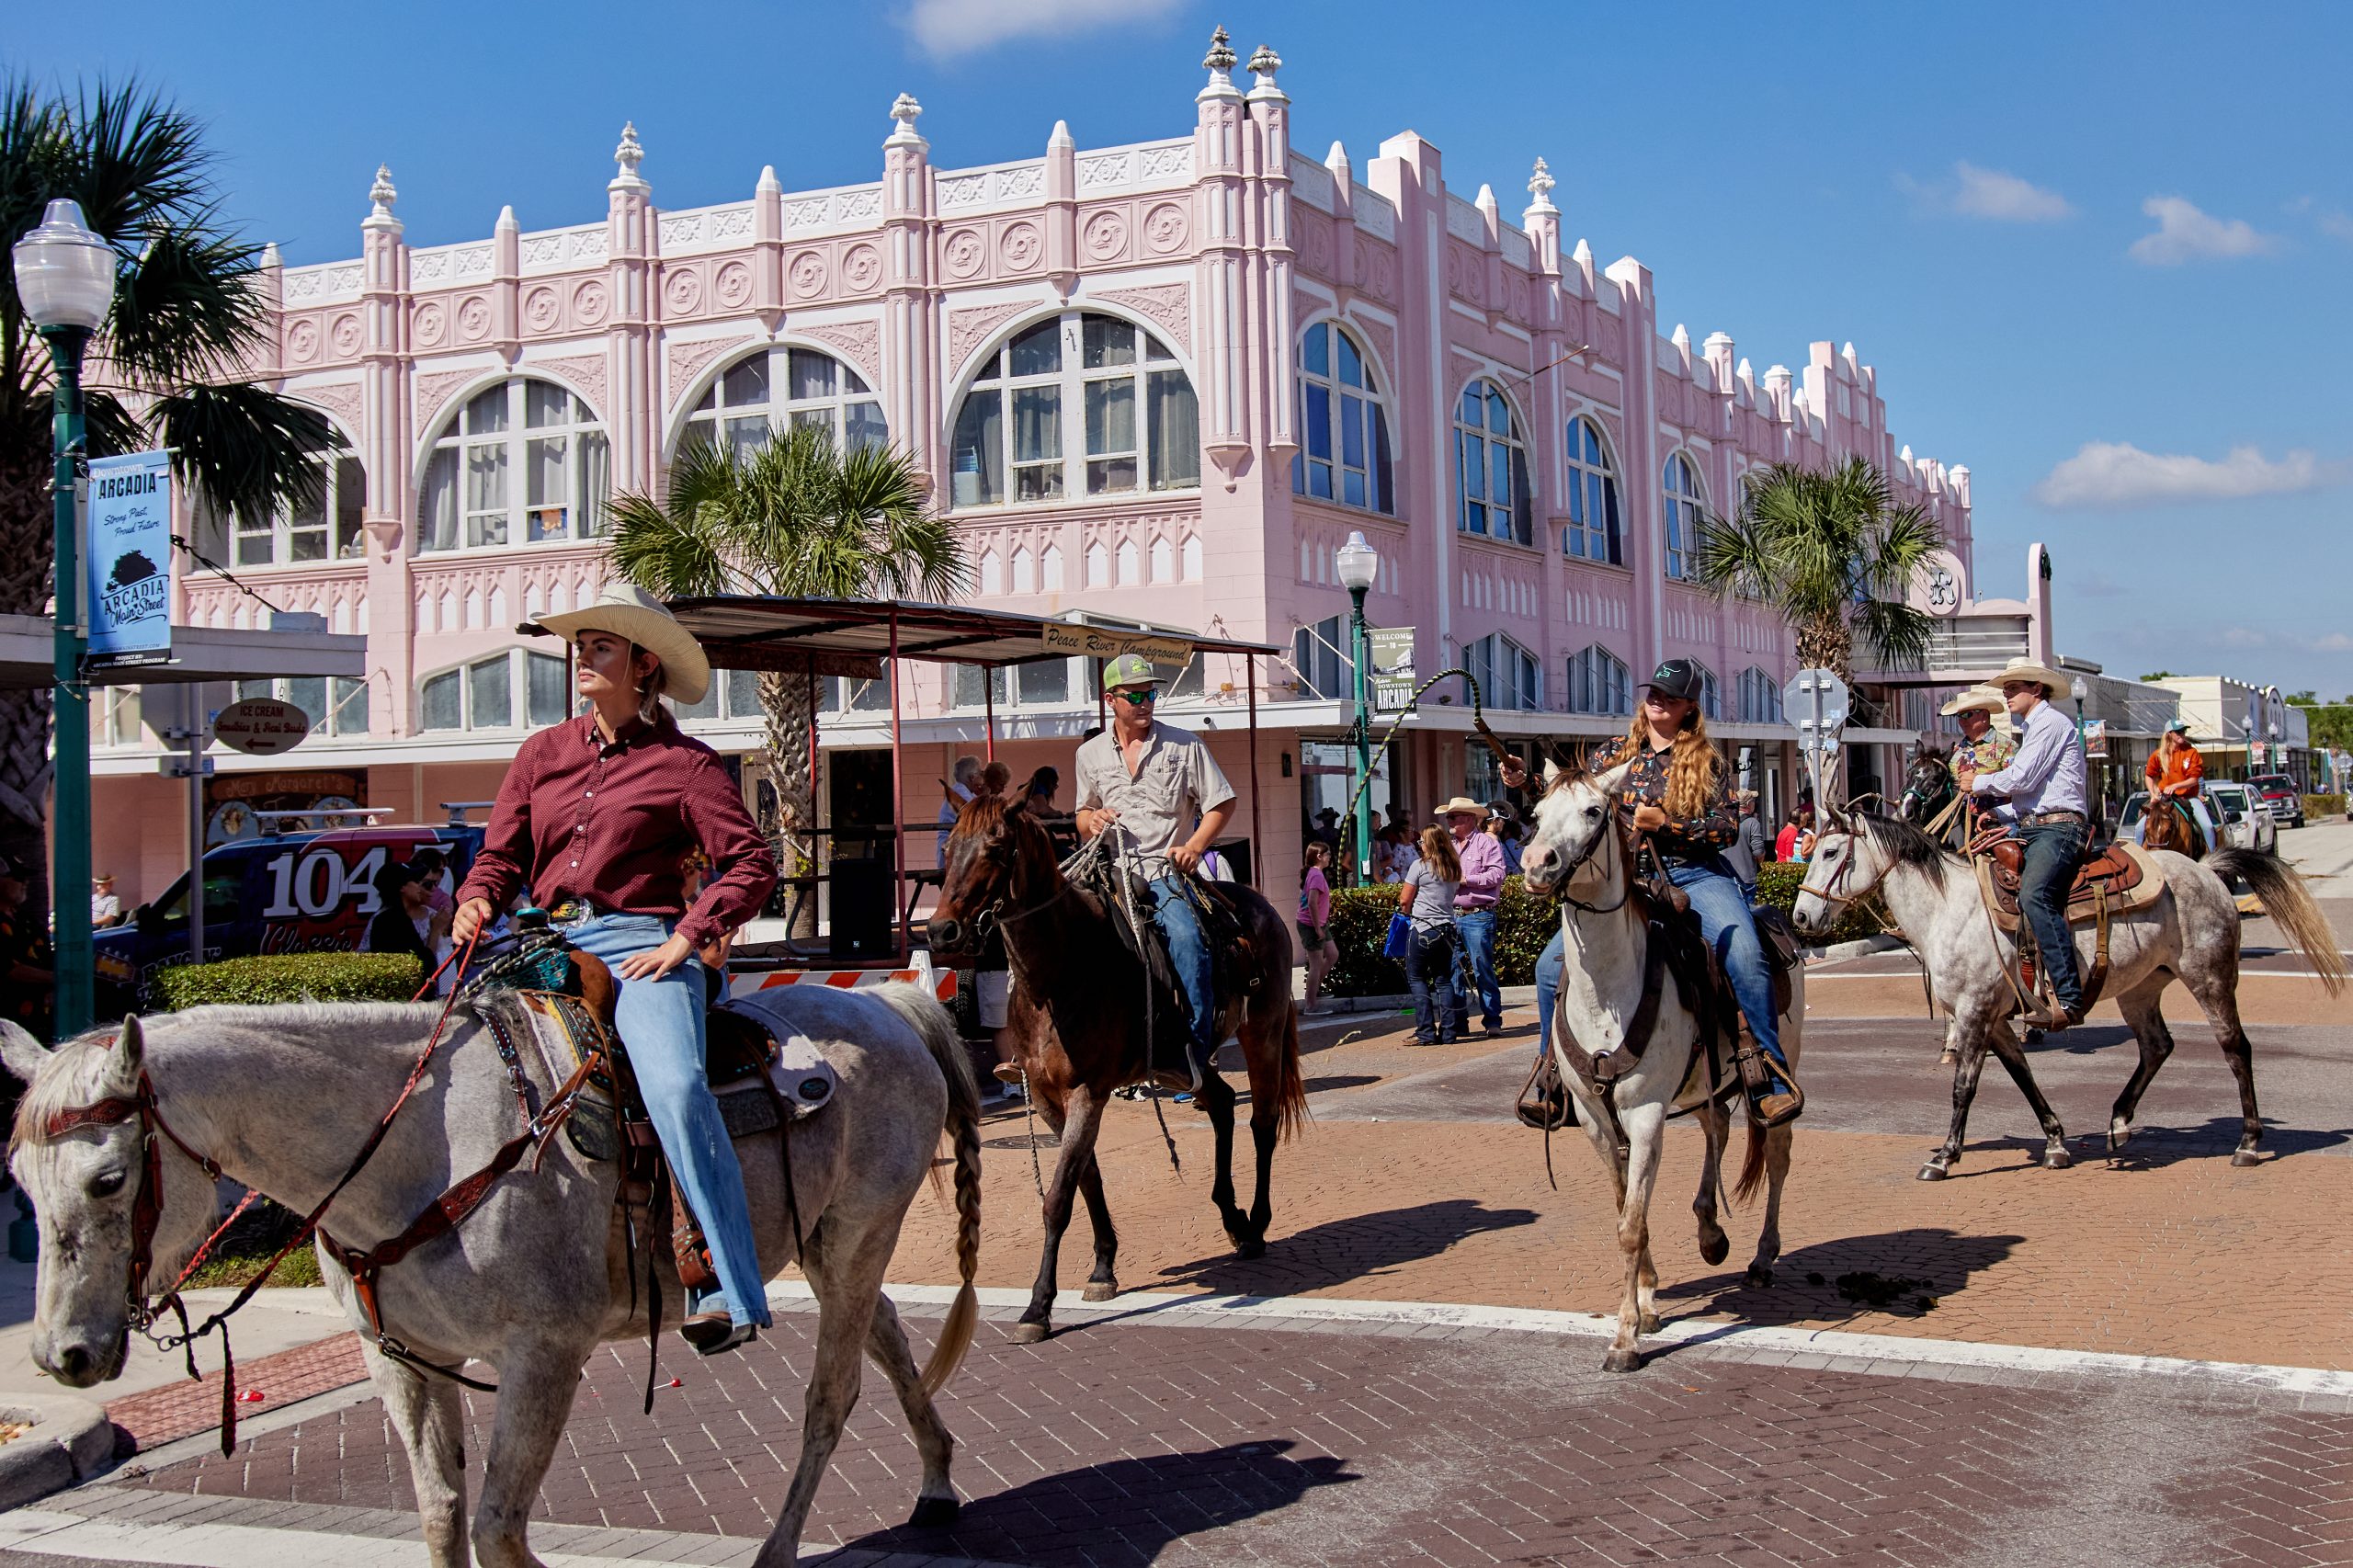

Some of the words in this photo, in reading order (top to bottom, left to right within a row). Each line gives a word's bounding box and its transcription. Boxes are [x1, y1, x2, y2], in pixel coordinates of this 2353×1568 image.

[93, 463, 143, 477] Downtown
[98, 472, 156, 499] ARCADIA
[104, 515, 127, 526] Strong
[129, 506, 148, 518] Past,
[114, 523, 136, 537] Proud
[138, 520, 160, 531] Future
[104, 580, 165, 615] ARCADIA
[110, 607, 135, 628] Main
[138, 596, 165, 615] Street
[1047, 628, 1079, 647] Peace
[1085, 634, 1116, 652] River
[1120, 640, 1188, 663] Campground
[1375, 632, 1411, 641] WELCOME
[1378, 688, 1415, 710] ARCADIA
[240, 706, 253, 717] ICE
[255, 705, 284, 717] CREAM
[253, 722, 260, 733] &
